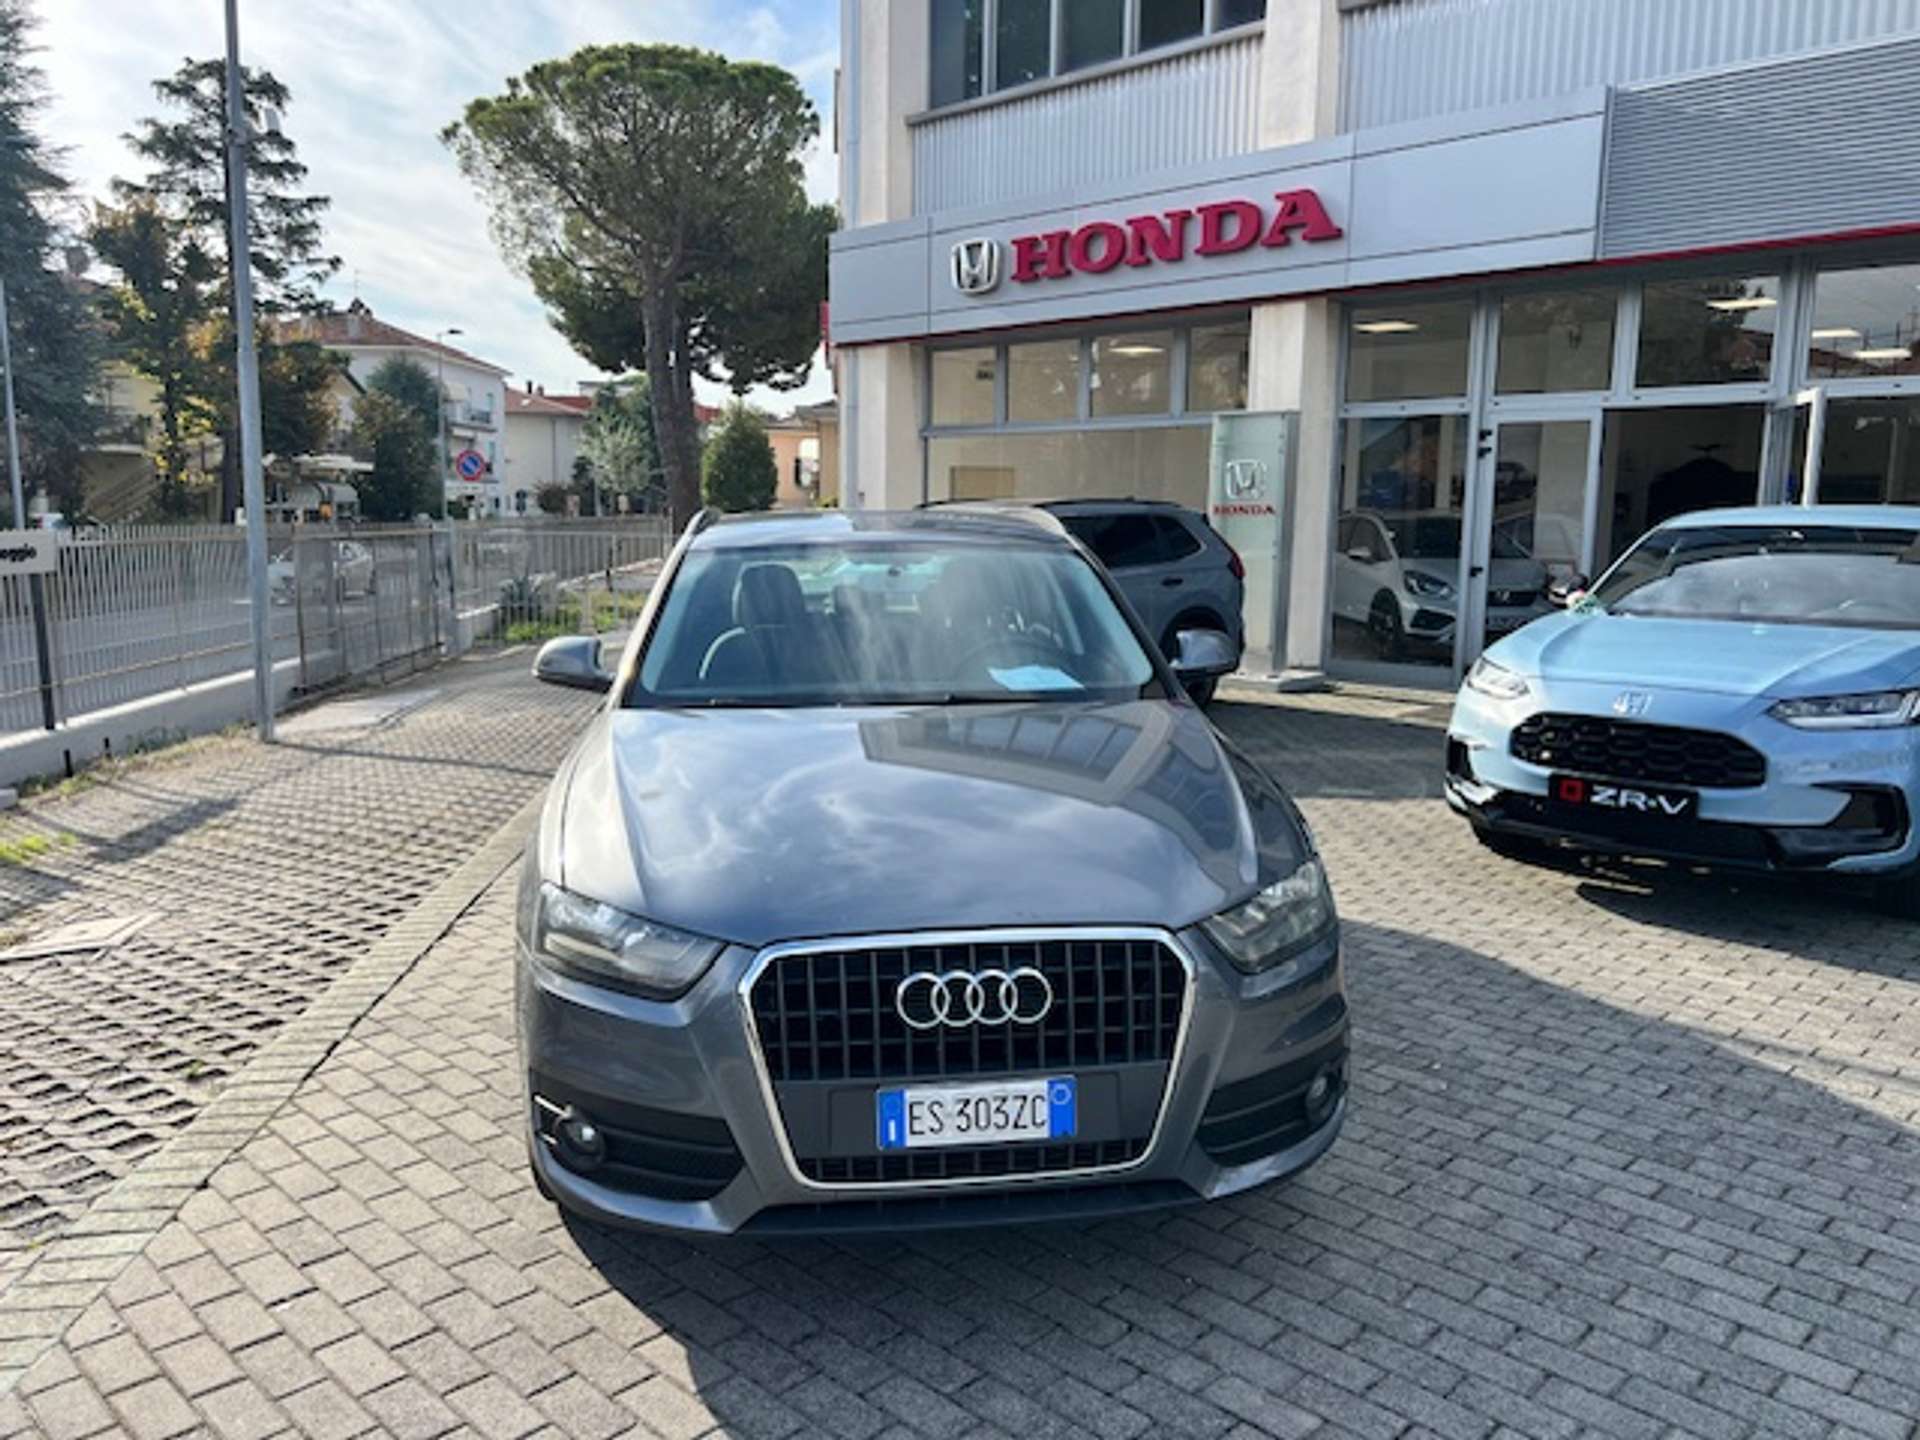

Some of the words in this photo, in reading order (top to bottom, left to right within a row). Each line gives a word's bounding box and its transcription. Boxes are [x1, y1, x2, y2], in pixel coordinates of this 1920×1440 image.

[1011, 188, 1342, 283] HONDA
[1213, 504, 1276, 516] HONDA
[909, 1101, 944, 1135] ES
[956, 1095, 1047, 1132] 303ZC
